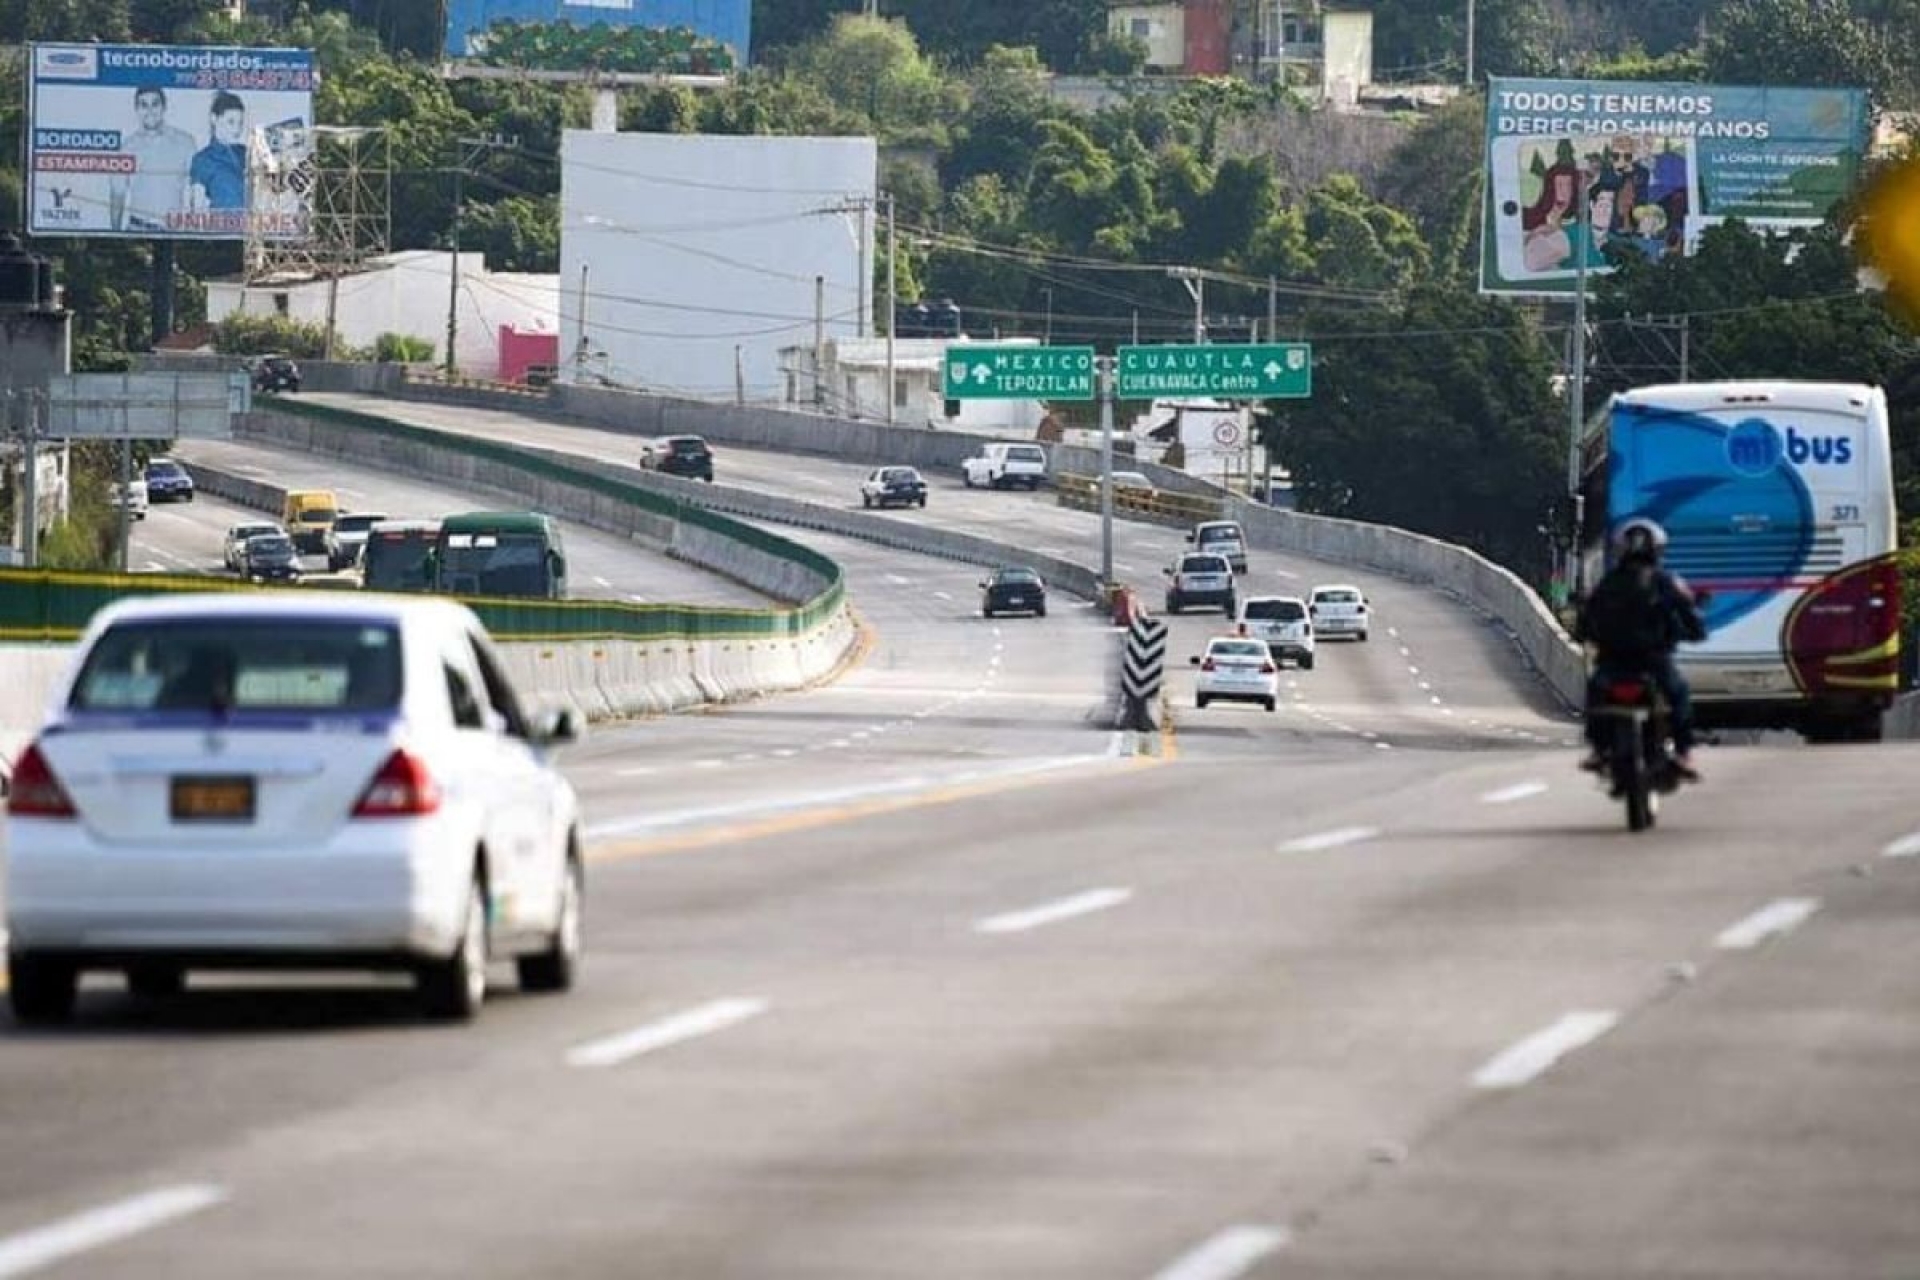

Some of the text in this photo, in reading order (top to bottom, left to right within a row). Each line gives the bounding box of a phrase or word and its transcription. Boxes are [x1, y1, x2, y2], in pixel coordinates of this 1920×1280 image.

[1500, 92, 1713, 115] TODOS TENEMOS
[1499, 116, 1769, 139] DERECHOS HUMANOS
[37, 131, 118, 148] BORDADO
[37, 157, 133, 171] ESTAMPADO
[995, 354, 1089, 370] MEXICO
[1127, 353, 1254, 369] CUAUTLA
[995, 375, 1089, 391] TEPOZTLAN
[1122, 373, 1259, 390] CUERNAVACA Centro
[1786, 426, 1851, 465] bus
[1831, 504, 1860, 521] 371
